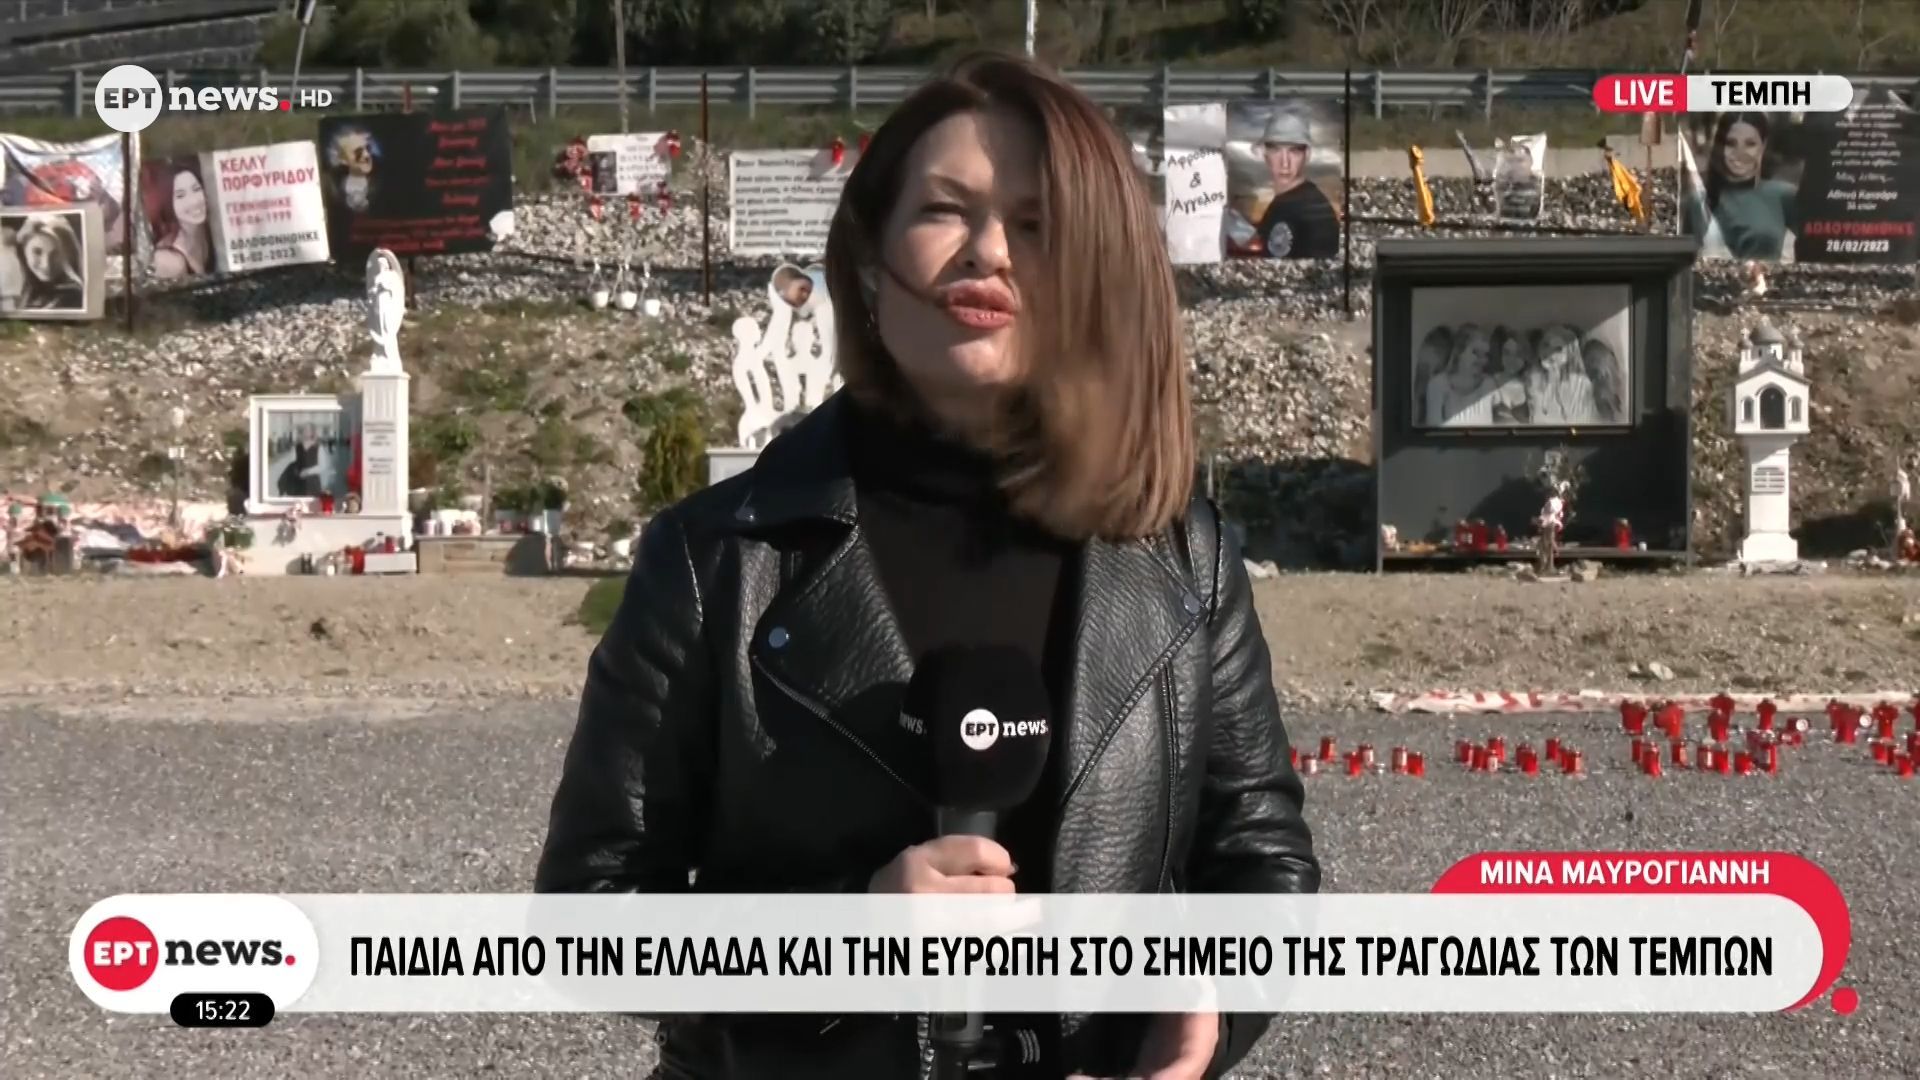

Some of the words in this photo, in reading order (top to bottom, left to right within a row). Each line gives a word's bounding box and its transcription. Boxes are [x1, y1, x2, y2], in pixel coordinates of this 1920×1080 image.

[220, 155, 267, 173] ΚΕΛΛΥ
[222, 167, 315, 192] ΠΟΡΦΥΡΙΔΟΥ
[1189, 171, 1202, 189] &
